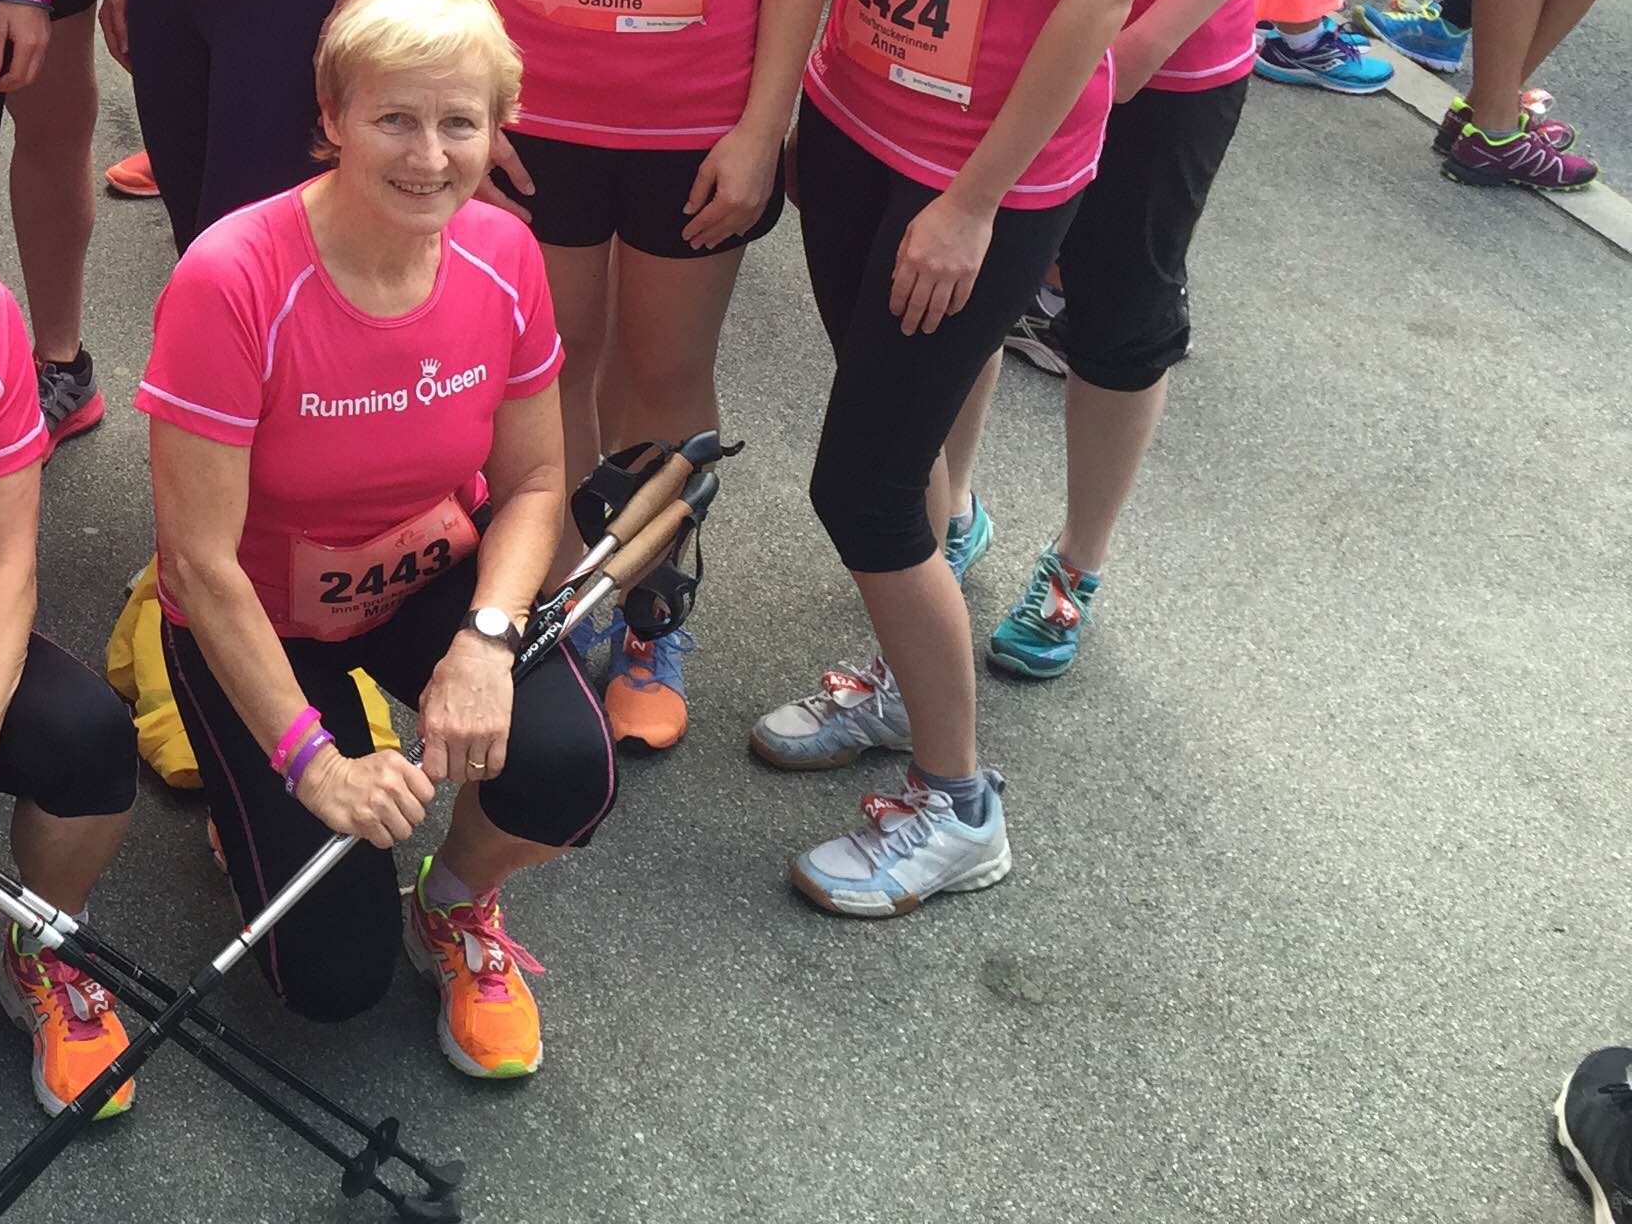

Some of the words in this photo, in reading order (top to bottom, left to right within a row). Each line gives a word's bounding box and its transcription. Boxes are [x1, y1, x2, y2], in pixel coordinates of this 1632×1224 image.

[870, 33, 907, 60] Anna
[300, 388, 408, 417] Running
[416, 364, 487, 406] Queen
[319, 538, 451, 604] 2443
